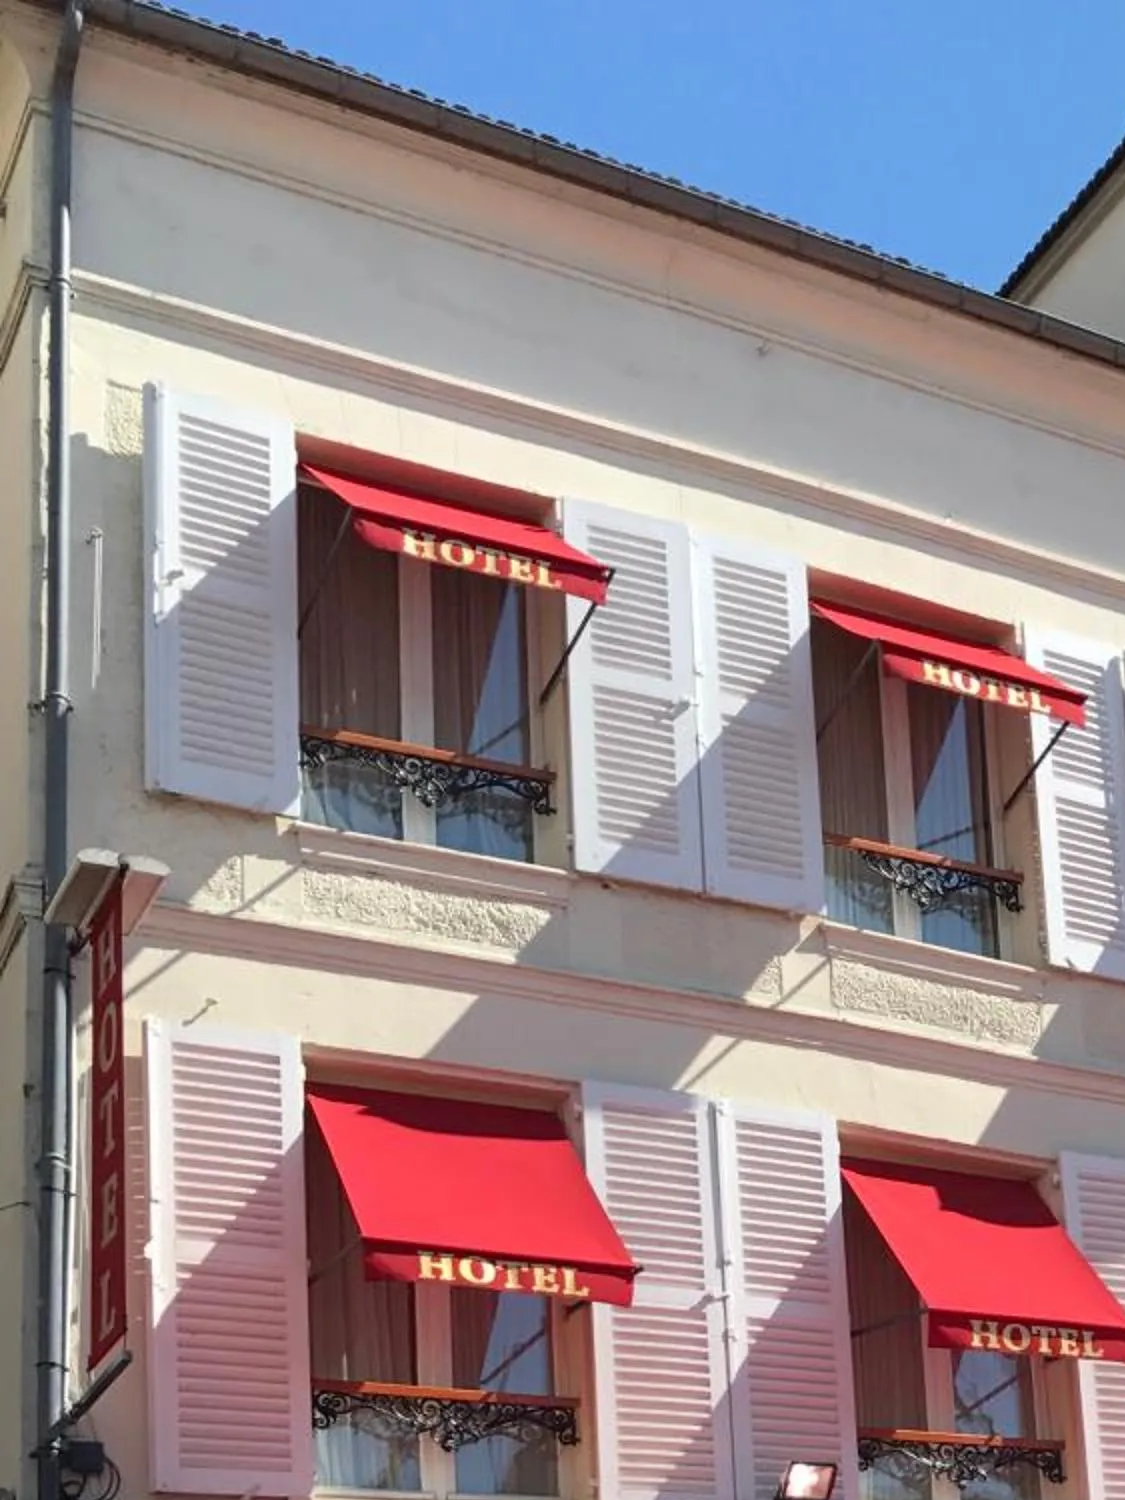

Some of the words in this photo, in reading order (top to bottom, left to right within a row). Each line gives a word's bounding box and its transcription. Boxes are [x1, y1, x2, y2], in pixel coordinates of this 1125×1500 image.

[401, 527, 563, 589] HOTEL
[921, 660, 1051, 713] HOTEL
[98, 906, 120, 1343] HOTEL
[416, 1250, 590, 1297] HOTEL
[969, 1319, 1104, 1357] HOTEL
